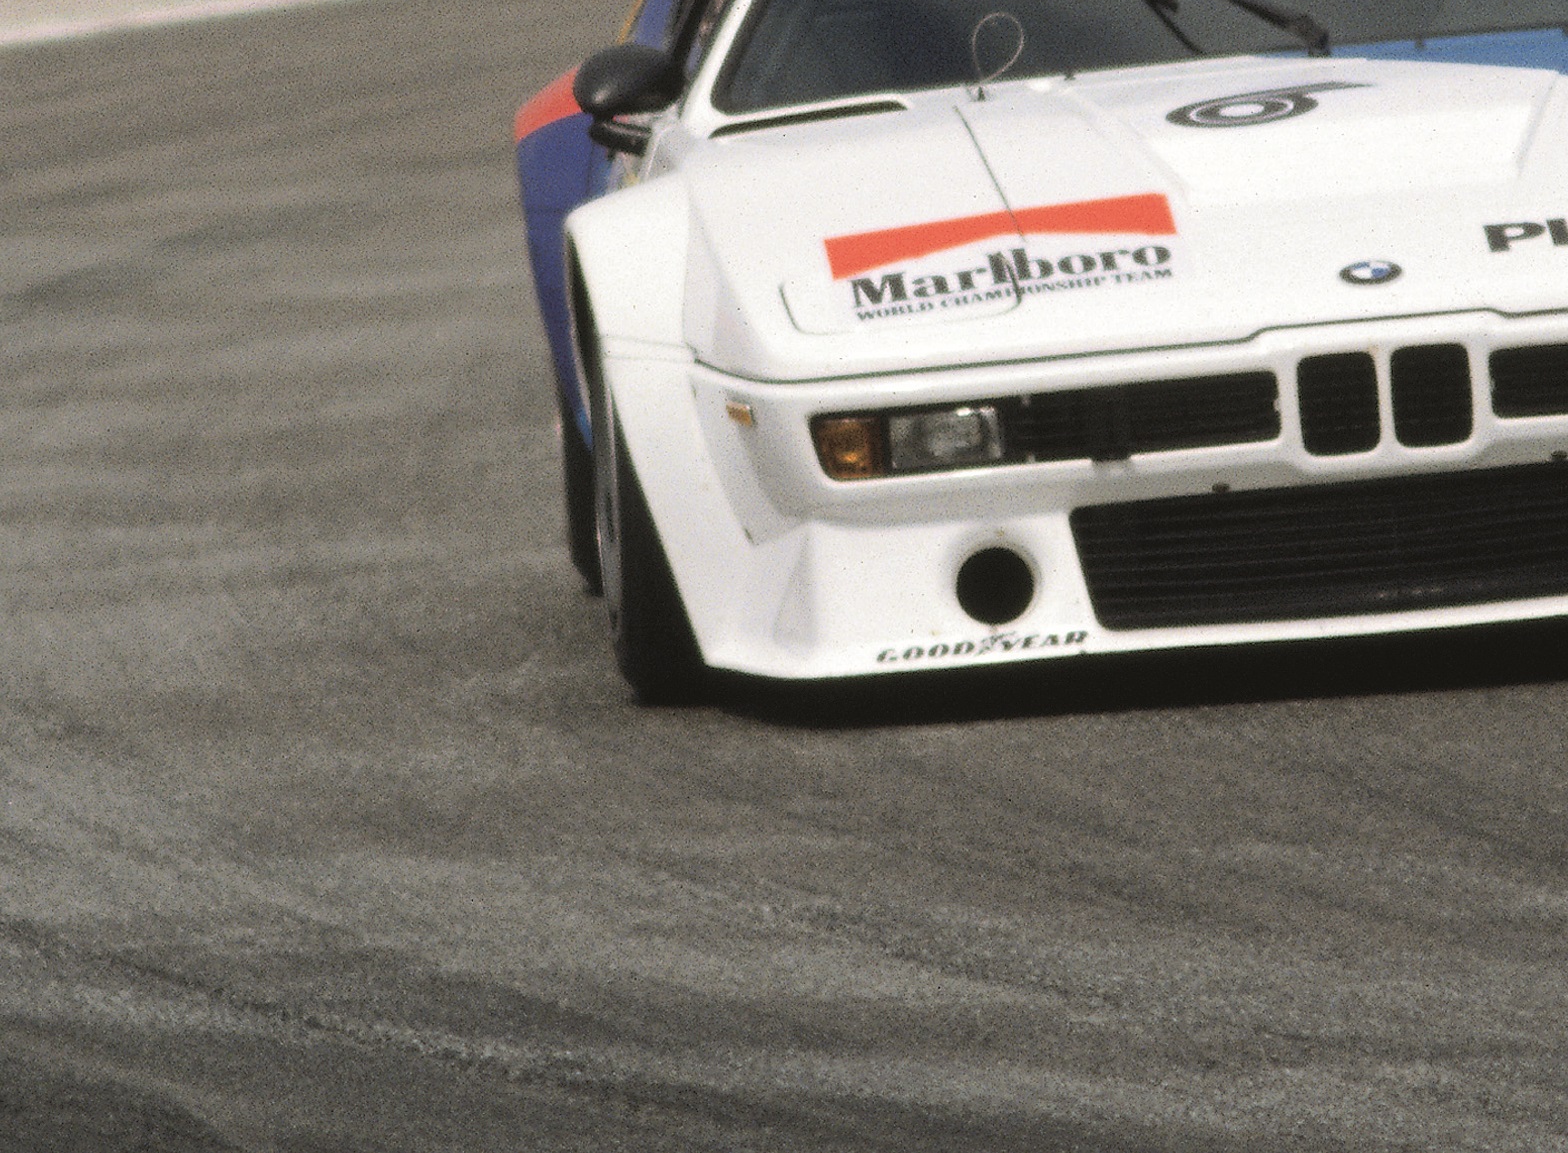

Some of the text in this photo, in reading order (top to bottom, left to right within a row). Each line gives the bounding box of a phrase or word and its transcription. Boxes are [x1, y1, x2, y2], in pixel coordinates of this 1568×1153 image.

[851, 246, 1171, 307] Marlboro
[857, 302, 934, 322] WORLD
[1114, 268, 1173, 282] TEAM
